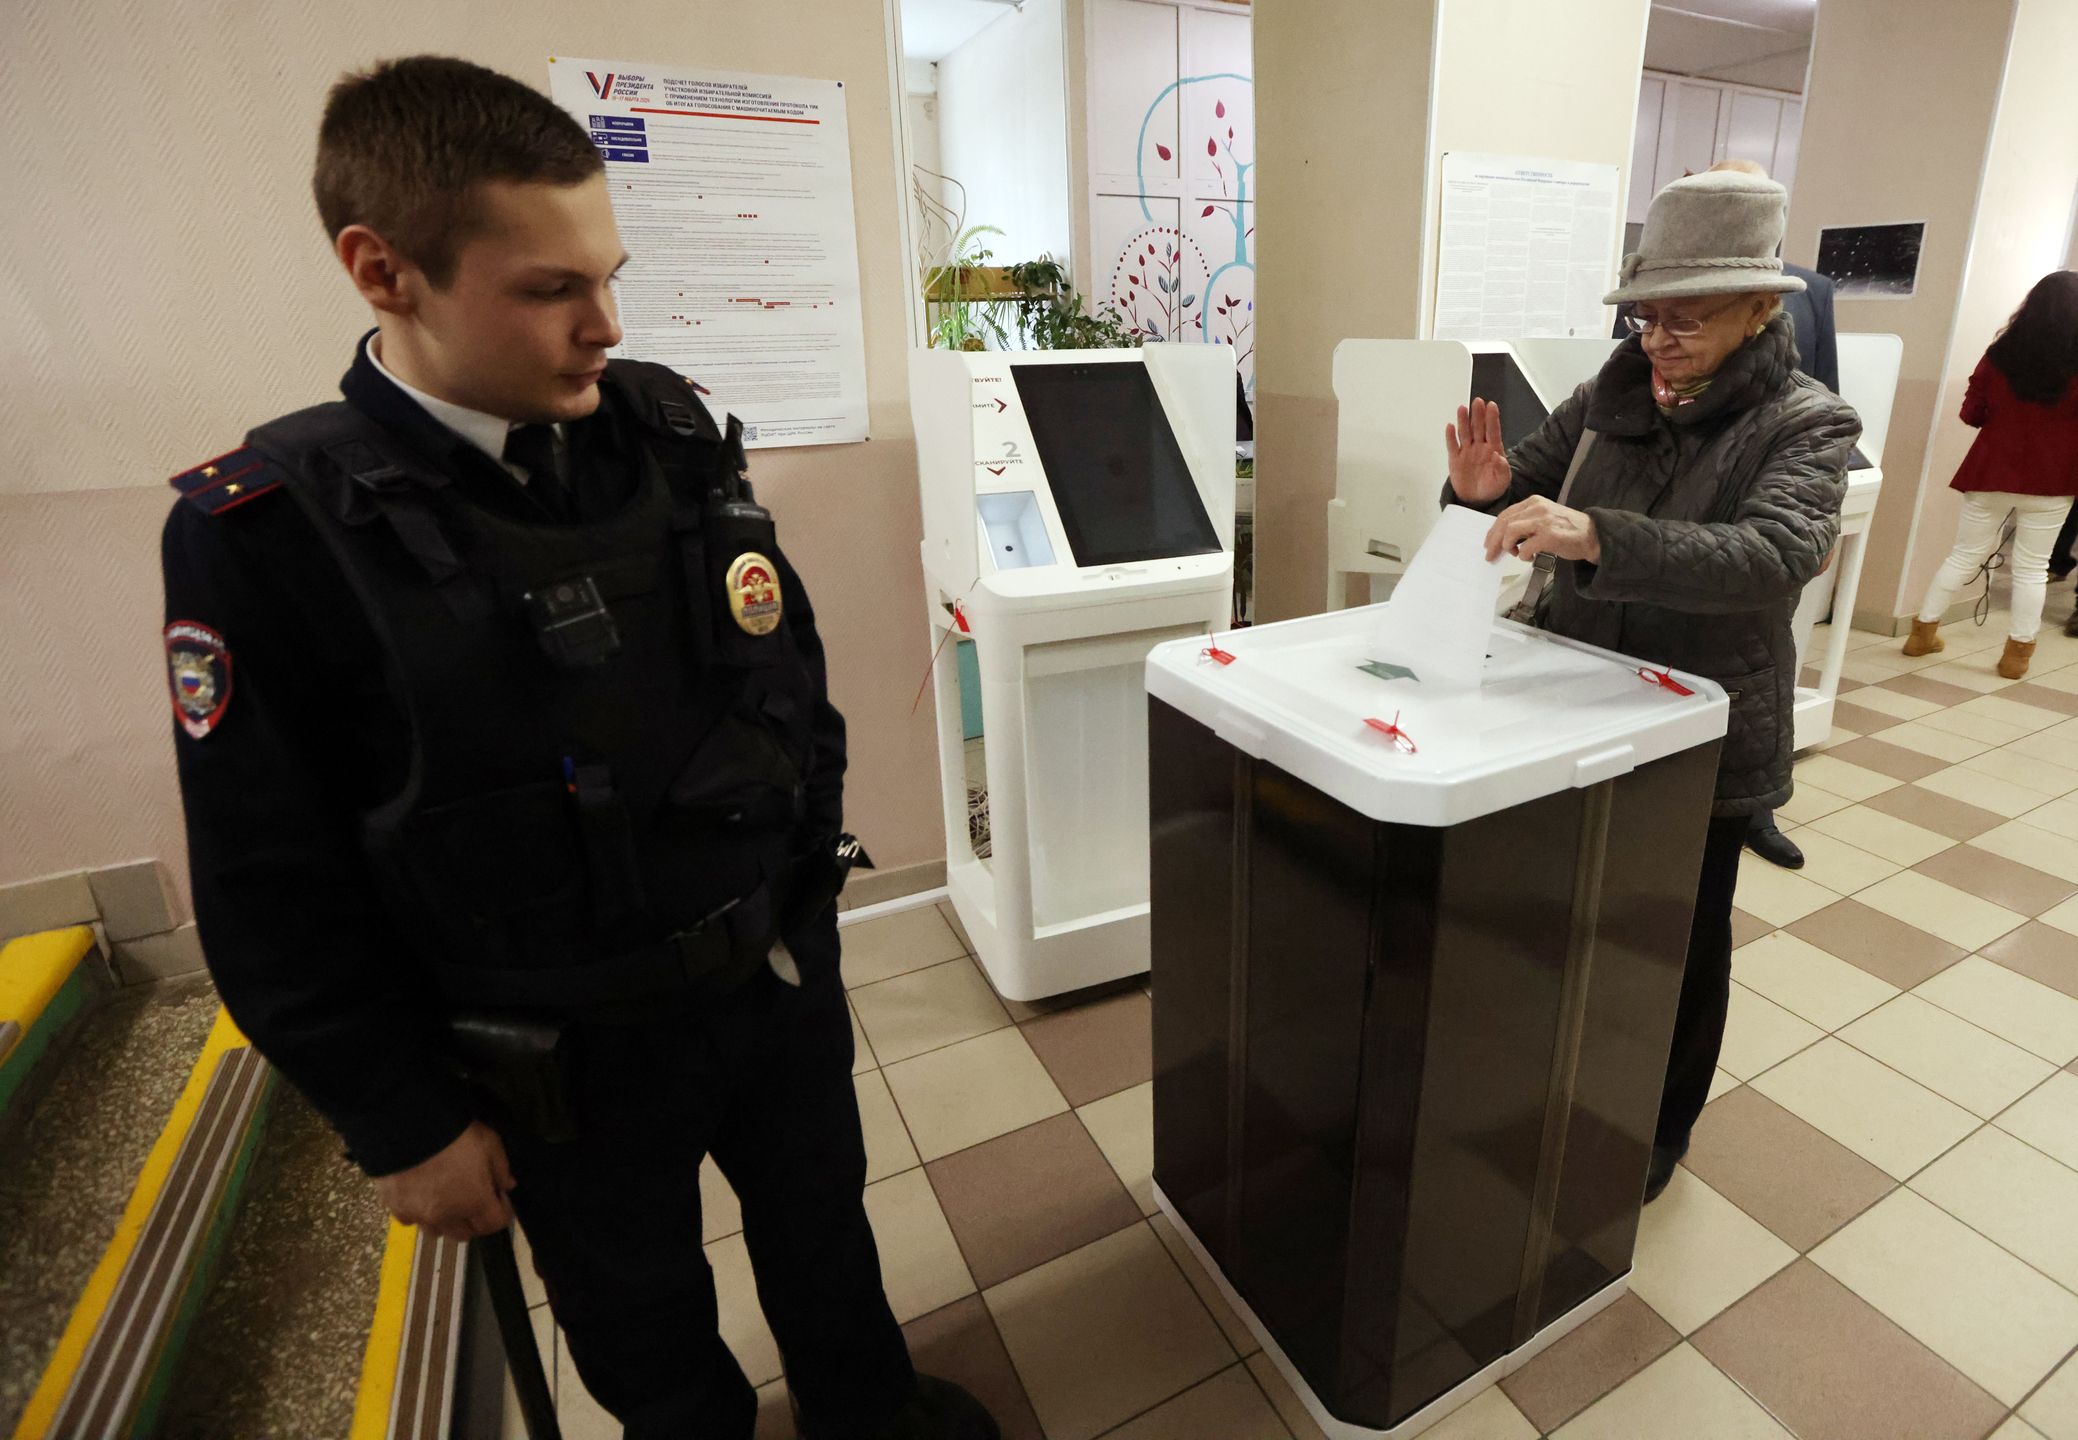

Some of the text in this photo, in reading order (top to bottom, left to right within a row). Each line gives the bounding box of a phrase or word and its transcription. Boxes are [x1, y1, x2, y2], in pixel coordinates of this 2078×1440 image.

[618, 74, 645, 82] ВЫБОРЫ
[615, 81, 654, 90] ПРЕЗИДЕНТА
[688, 80, 711, 88] ГОЛОСОВ
[713, 82, 748, 90] ИЗБИРАТЕЛЕЙ
[664, 86, 771, 100] УЧАСТКОВОЙ ИЗБИРАТЕЛЬНОЙ КОМИССИЕЙ
[670, 93, 708, 101] ПРИМЕНЕНИЕМ
[709, 96, 741, 104] ТЕХНОЛОГИИ
[742, 99, 780, 107] ИЗГОТОВЛЕНИЯ
[694, 102, 731, 110] ГОЛОСОВАНИЯ
[736, 105, 786, 114] МАШИНОЧИТАЕМЫМ
[1002, 441, 1021, 458] 2
